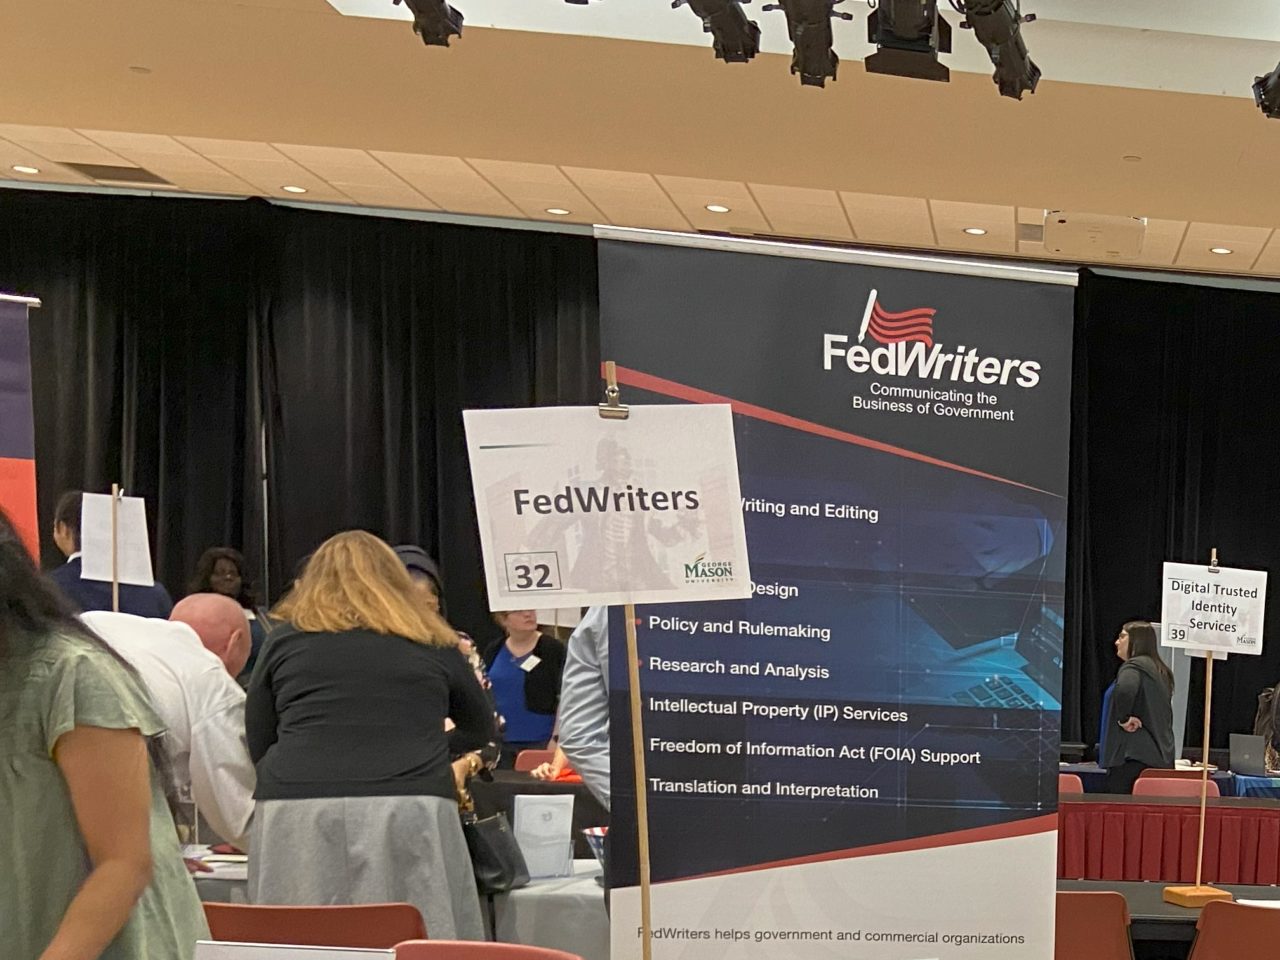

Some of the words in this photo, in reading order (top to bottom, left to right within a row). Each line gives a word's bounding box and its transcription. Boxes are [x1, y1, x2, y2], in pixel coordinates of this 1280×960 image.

[823, 334, 1041, 388] FedWriters
[870, 382, 973, 406] Communicating
[977, 392, 997, 405] the
[852, 396, 913, 413] Business
[917, 402, 930, 415] of
[934, 403, 1015, 421] Government
[513, 485, 700, 515] FedWriters
[741, 497, 785, 517] riting
[790, 502, 819, 517] and
[824, 504, 879, 524] Editing
[514, 563, 553, 589] 32
[684, 562, 733, 578] MASON
[1171, 580, 1210, 594] Digital
[1213, 584, 1258, 598] Trusted
[1191, 600, 1237, 617] Identity
[649, 615, 699, 635] Policy
[703, 620, 733, 634] and
[738, 621, 831, 642] Rulemaking
[1171, 629, 1186, 640] 39
[1189, 618, 1237, 633] Services
[649, 657, 725, 674] Research
[729, 662, 760, 675] and
[764, 663, 830, 681] Analysis
[650, 697, 737, 714] Intellectual
[742, 702, 809, 721] Property
[813, 704, 839, 722] (IP)
[843, 706, 908, 722] Services
[650, 738, 721, 754] Freedom
[726, 741, 743, 755] of
[746, 742, 835, 758] Information
[839, 745, 865, 759] Act
[869, 746, 916, 764] (FOIA)
[920, 749, 981, 766] Support
[650, 778, 737, 795] Translation
[741, 782, 771, 795] and
[776, 782, 878, 799] Interpretation
[715, 928, 750, 942] helps
[755, 929, 832, 943] government
[837, 930, 861, 941] and
[865, 931, 938, 943] commercial
[942, 933, 1025, 945] organizations
